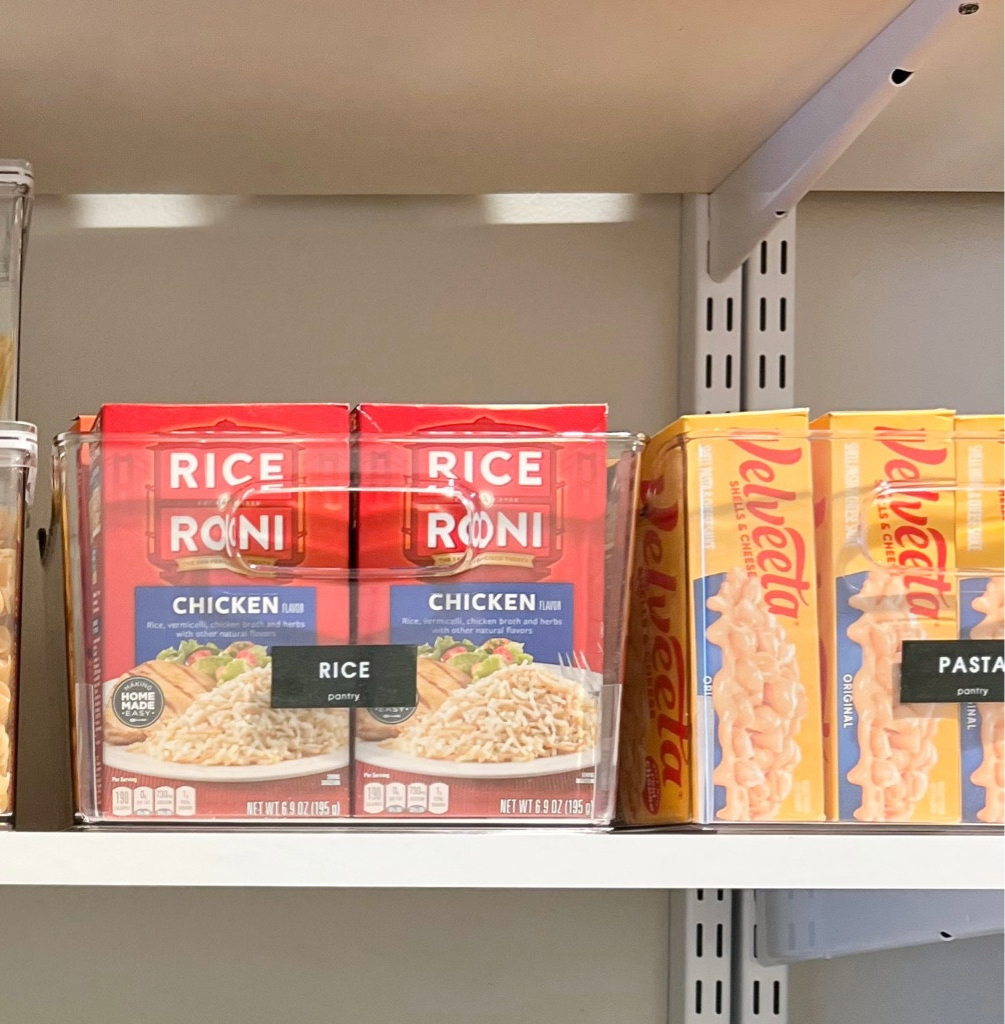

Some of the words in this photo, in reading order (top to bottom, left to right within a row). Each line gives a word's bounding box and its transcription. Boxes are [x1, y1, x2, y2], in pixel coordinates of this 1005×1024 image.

[171, 453, 283, 490] RICE
[429, 451, 542, 489] RICE
[728, 432, 810, 619] Velveeta
[874, 427, 951, 619] Velveeta
[172, 596, 278, 614] CHICKEN
[282, 603, 304, 613] FLAVOR
[428, 593, 536, 611] CHICKEN
[539, 600, 561, 610] FLAVOR
[319, 662, 370, 679] RICE
[939, 656, 1005, 673] PASTA
[121, 692, 155, 701] HOME
[328, 692, 360, 702] pantry
[843, 674, 853, 728] ORIGINAL
[957, 688, 988, 696] pantry
